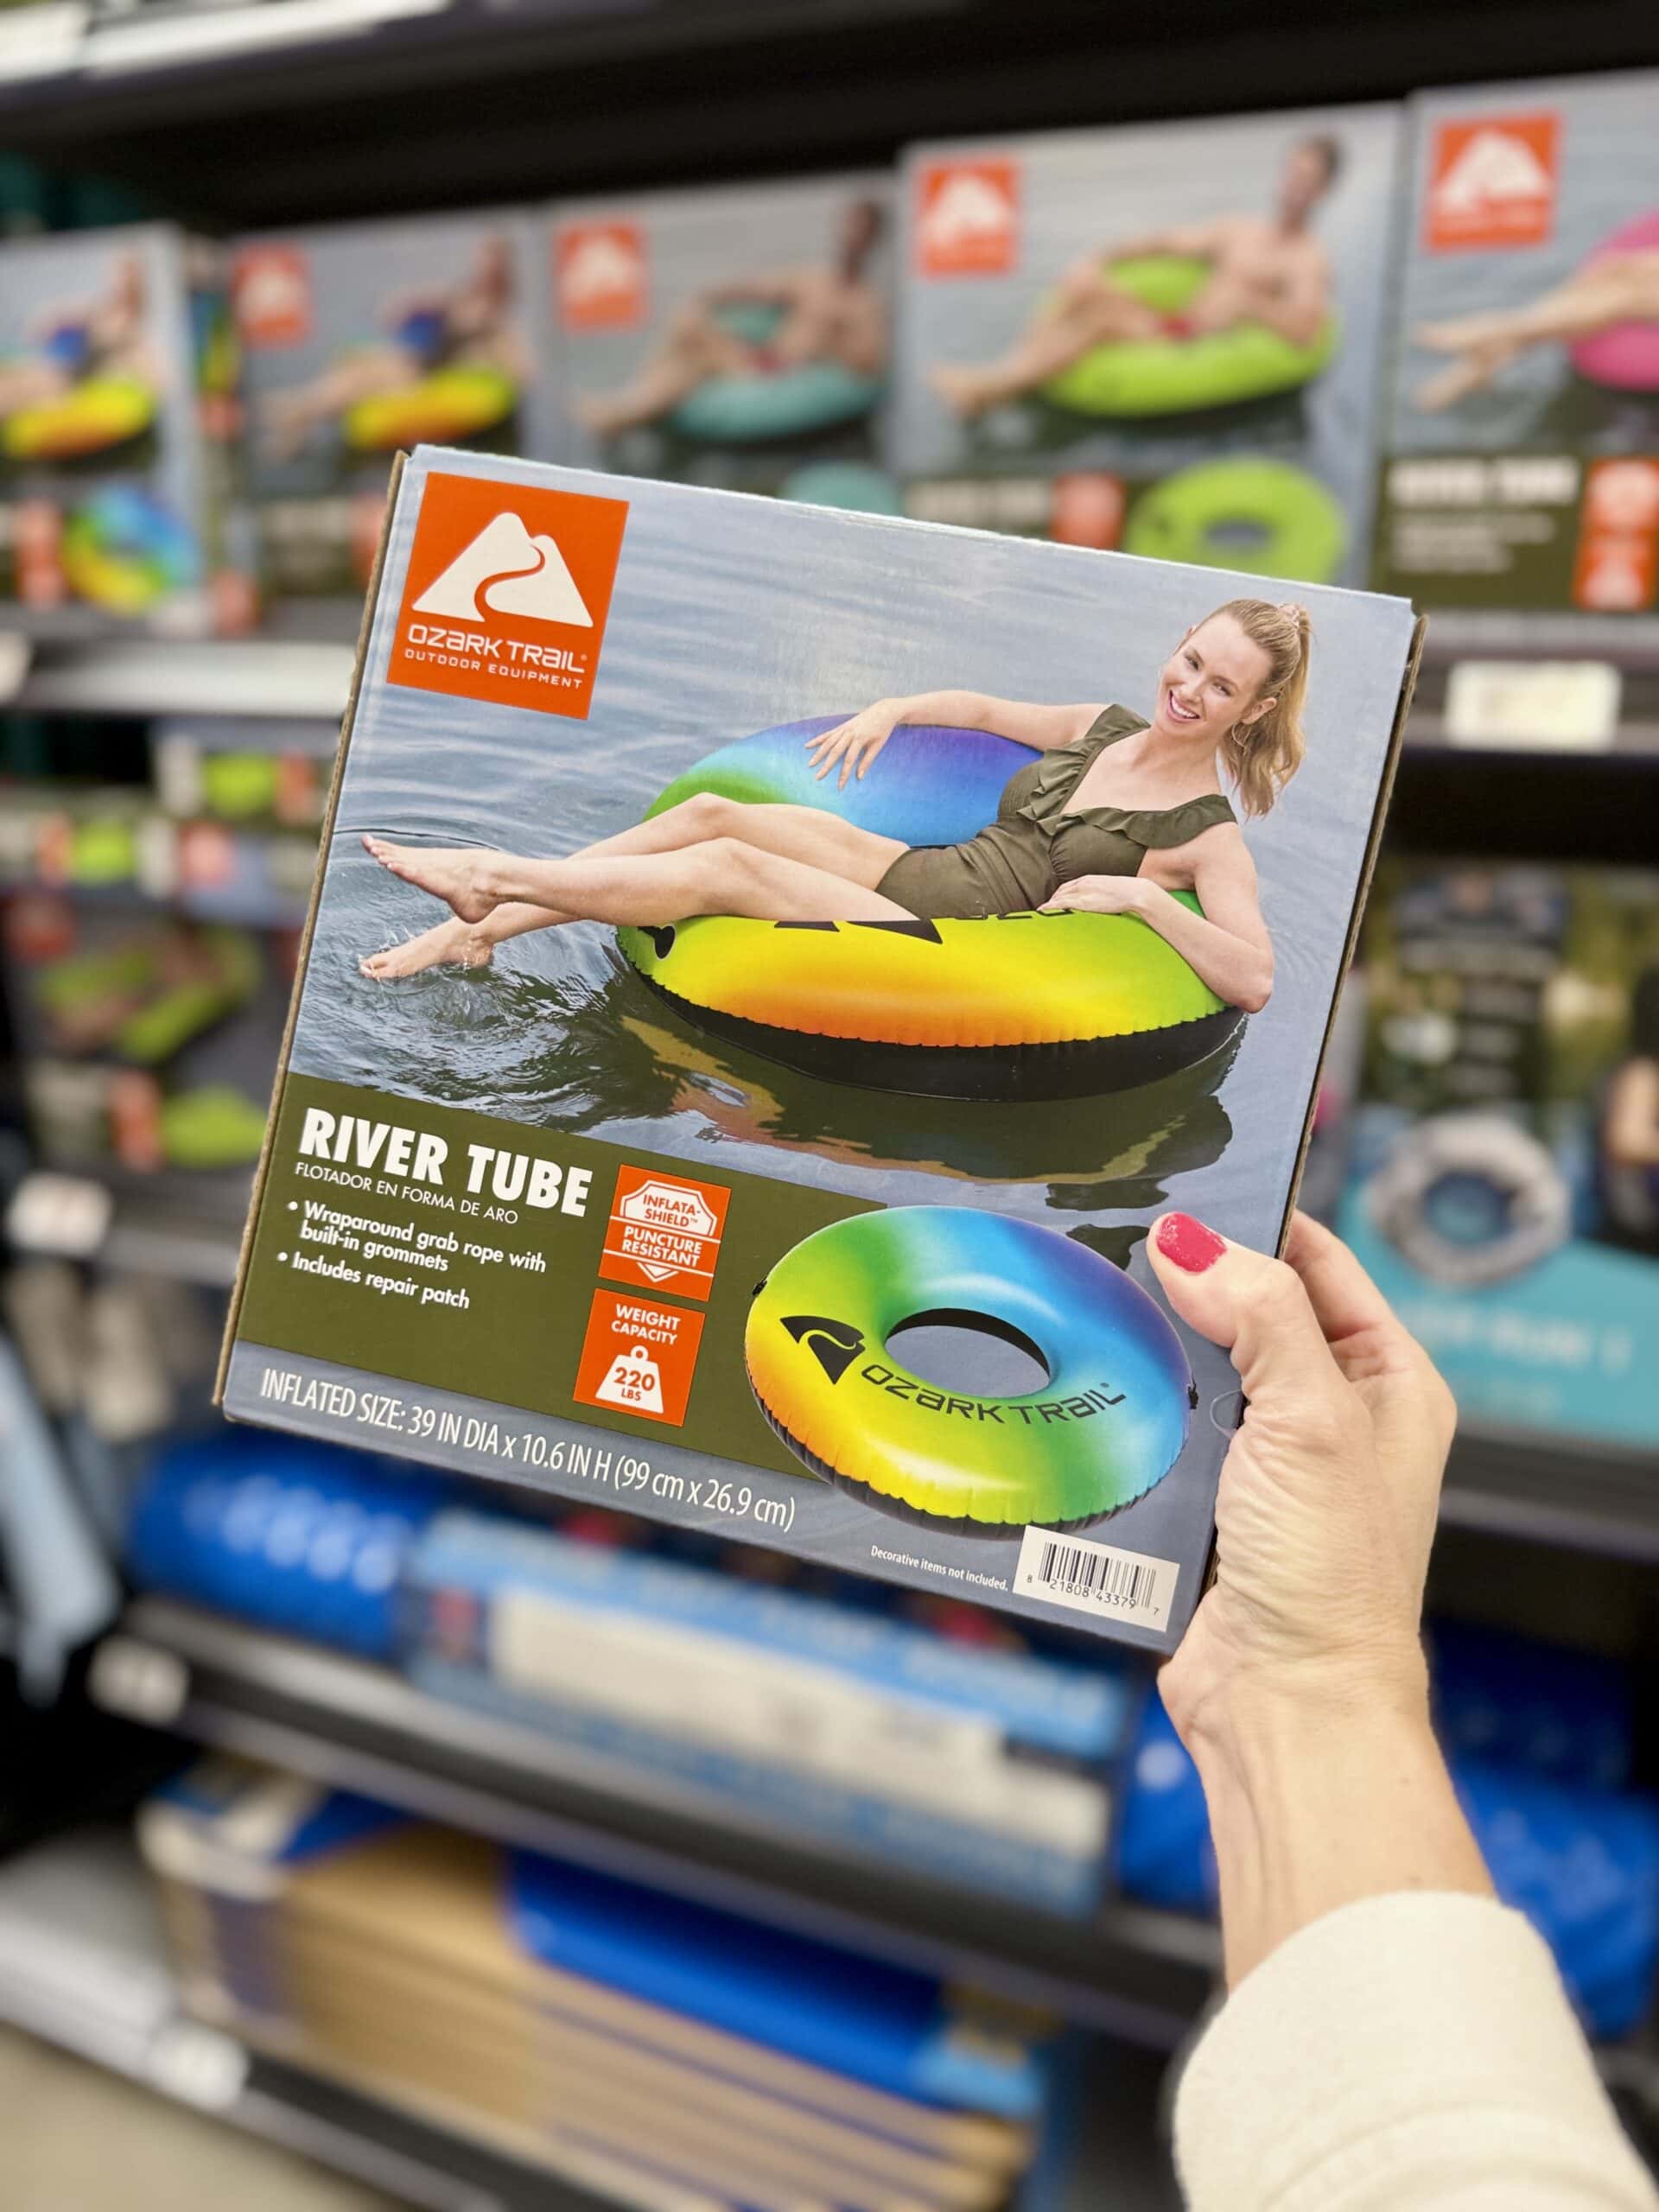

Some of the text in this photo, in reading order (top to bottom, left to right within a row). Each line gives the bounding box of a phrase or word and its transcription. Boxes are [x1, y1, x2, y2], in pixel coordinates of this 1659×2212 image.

[404, 649, 583, 690] OUTDOOR EQUIPMENT
[298, 1108, 593, 1217] RIVER TUBE
[295, 1162, 518, 1224] FLOTADOR EN FORMA DE ARO
[643, 1193, 701, 1216] INFLATA-
[299, 1219, 449, 1272] built-in grommets
[302, 1199, 547, 1273] Wraparound grab rope with
[621, 1239, 701, 1268] RESISTANT
[624, 1225, 702, 1255] PUNCTURE
[291, 1251, 471, 1309] Includes repair patch
[611, 1319, 678, 1345] CAPACITY
[615, 1303, 682, 1332] WEIGHT
[613, 1366, 656, 1392] 220
[620, 1387, 642, 1402] LBS
[260, 1368, 796, 1533] INFLATED SIZE: 39 IN DIA x 10.6 IN H (99 cm x 26.9 cm)
[870, 1545, 1008, 1592] Decorative items not included.
[1049, 1578, 1090, 1599] 21808
[1095, 1592, 1137, 1611] 43379
